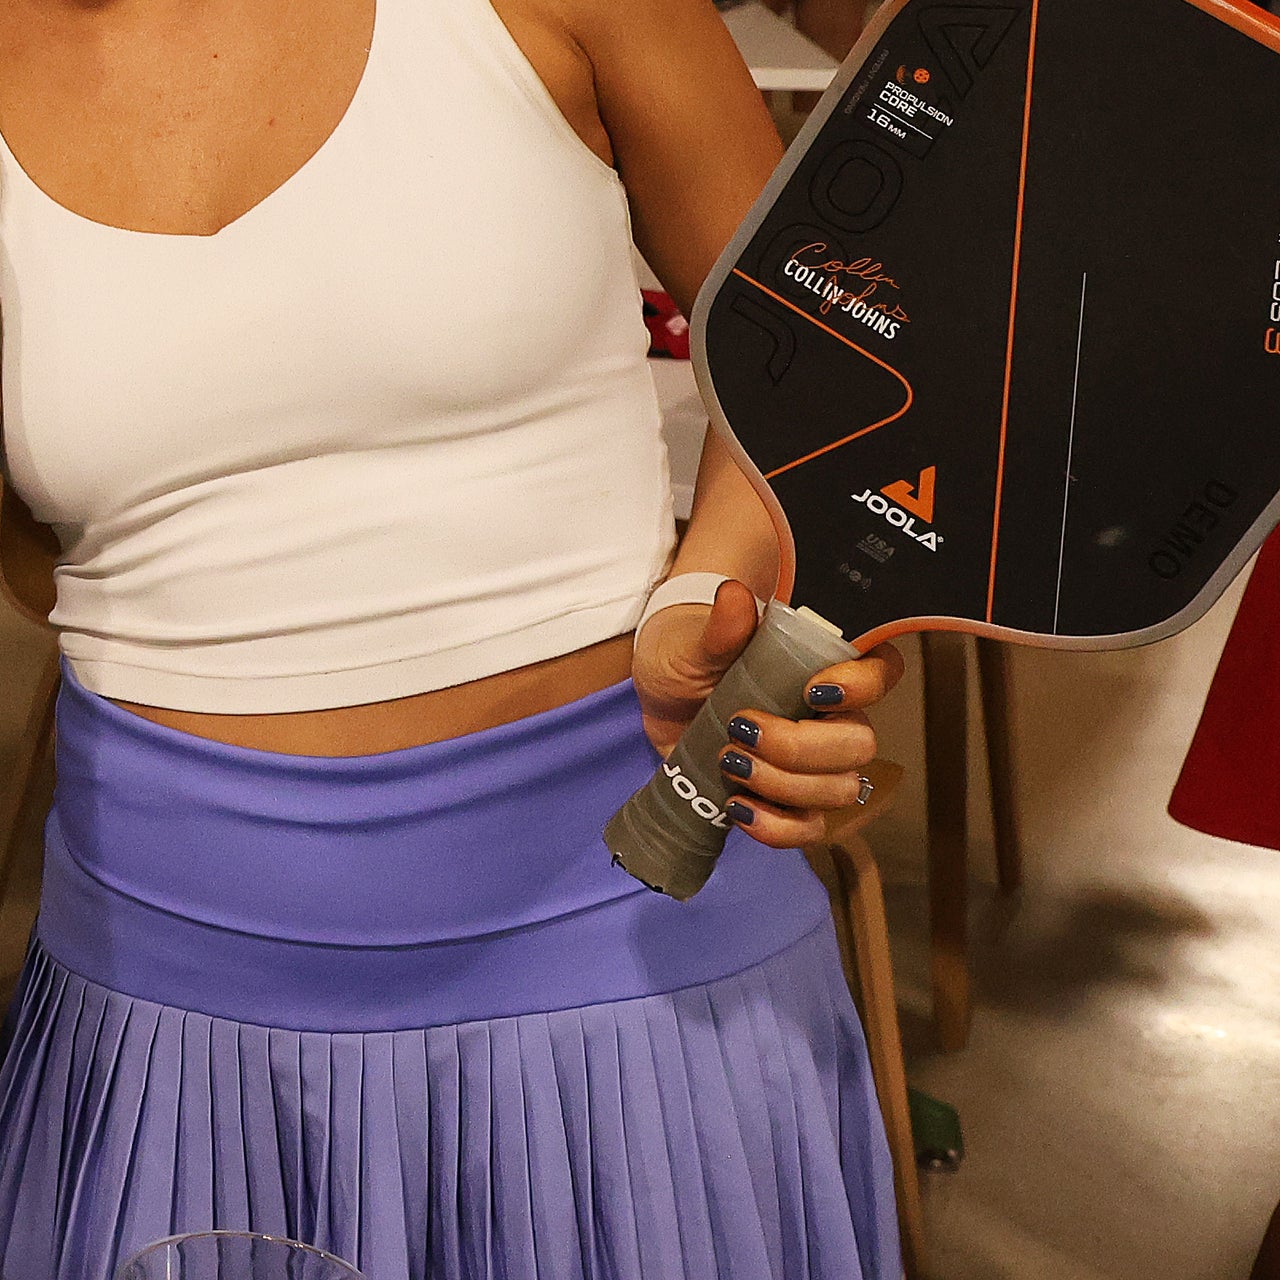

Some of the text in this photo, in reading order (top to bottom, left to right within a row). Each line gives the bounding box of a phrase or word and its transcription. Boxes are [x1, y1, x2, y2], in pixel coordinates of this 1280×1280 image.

[879, 90, 918, 118] CORE
[885, 81, 954, 127] PROPULSION
[784, 259, 901, 340] COLLIN JOHNS
[850, 488, 939, 552] JOOLA
[663, 762, 729, 828] JOOL
